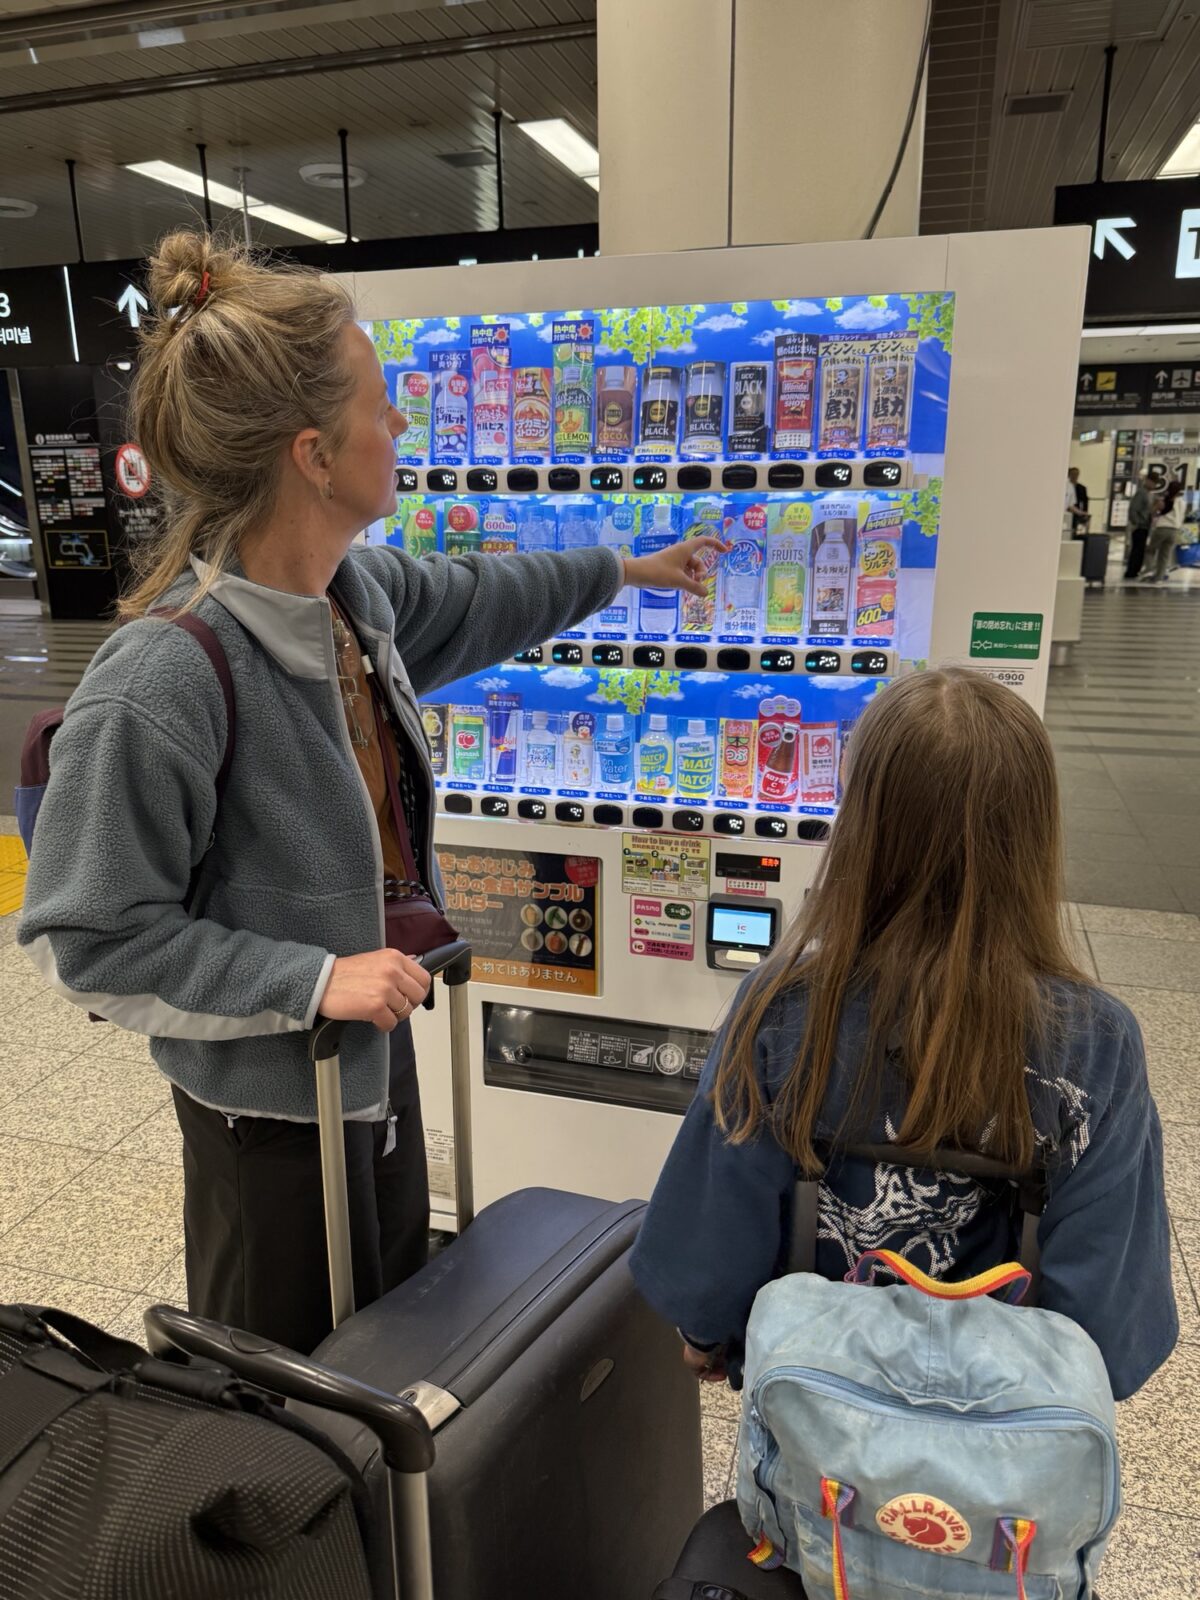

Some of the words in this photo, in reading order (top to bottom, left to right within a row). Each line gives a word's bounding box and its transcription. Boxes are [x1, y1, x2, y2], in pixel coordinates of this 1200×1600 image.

[735, 380, 763, 396] BLACK
[783, 383, 808, 392] Wonda
[784, 400, 806, 408] SHOT
[414, 416, 429, 426] BOSS
[476, 422, 504, 431] カルピス
[689, 423, 715, 432] BLACK
[645, 427, 669, 436] BLACK
[563, 432, 590, 441] LEMON
[598, 432, 629, 441] COCOA
[485, 520, 516, 531] 600ml
[771, 549, 804, 561] FRUITS
[632, 835, 648, 844] How
[650, 836, 657, 844] to
[659, 836, 672, 846] buy
[680, 839, 701, 848] drink
[636, 904, 660, 912] PASMO
